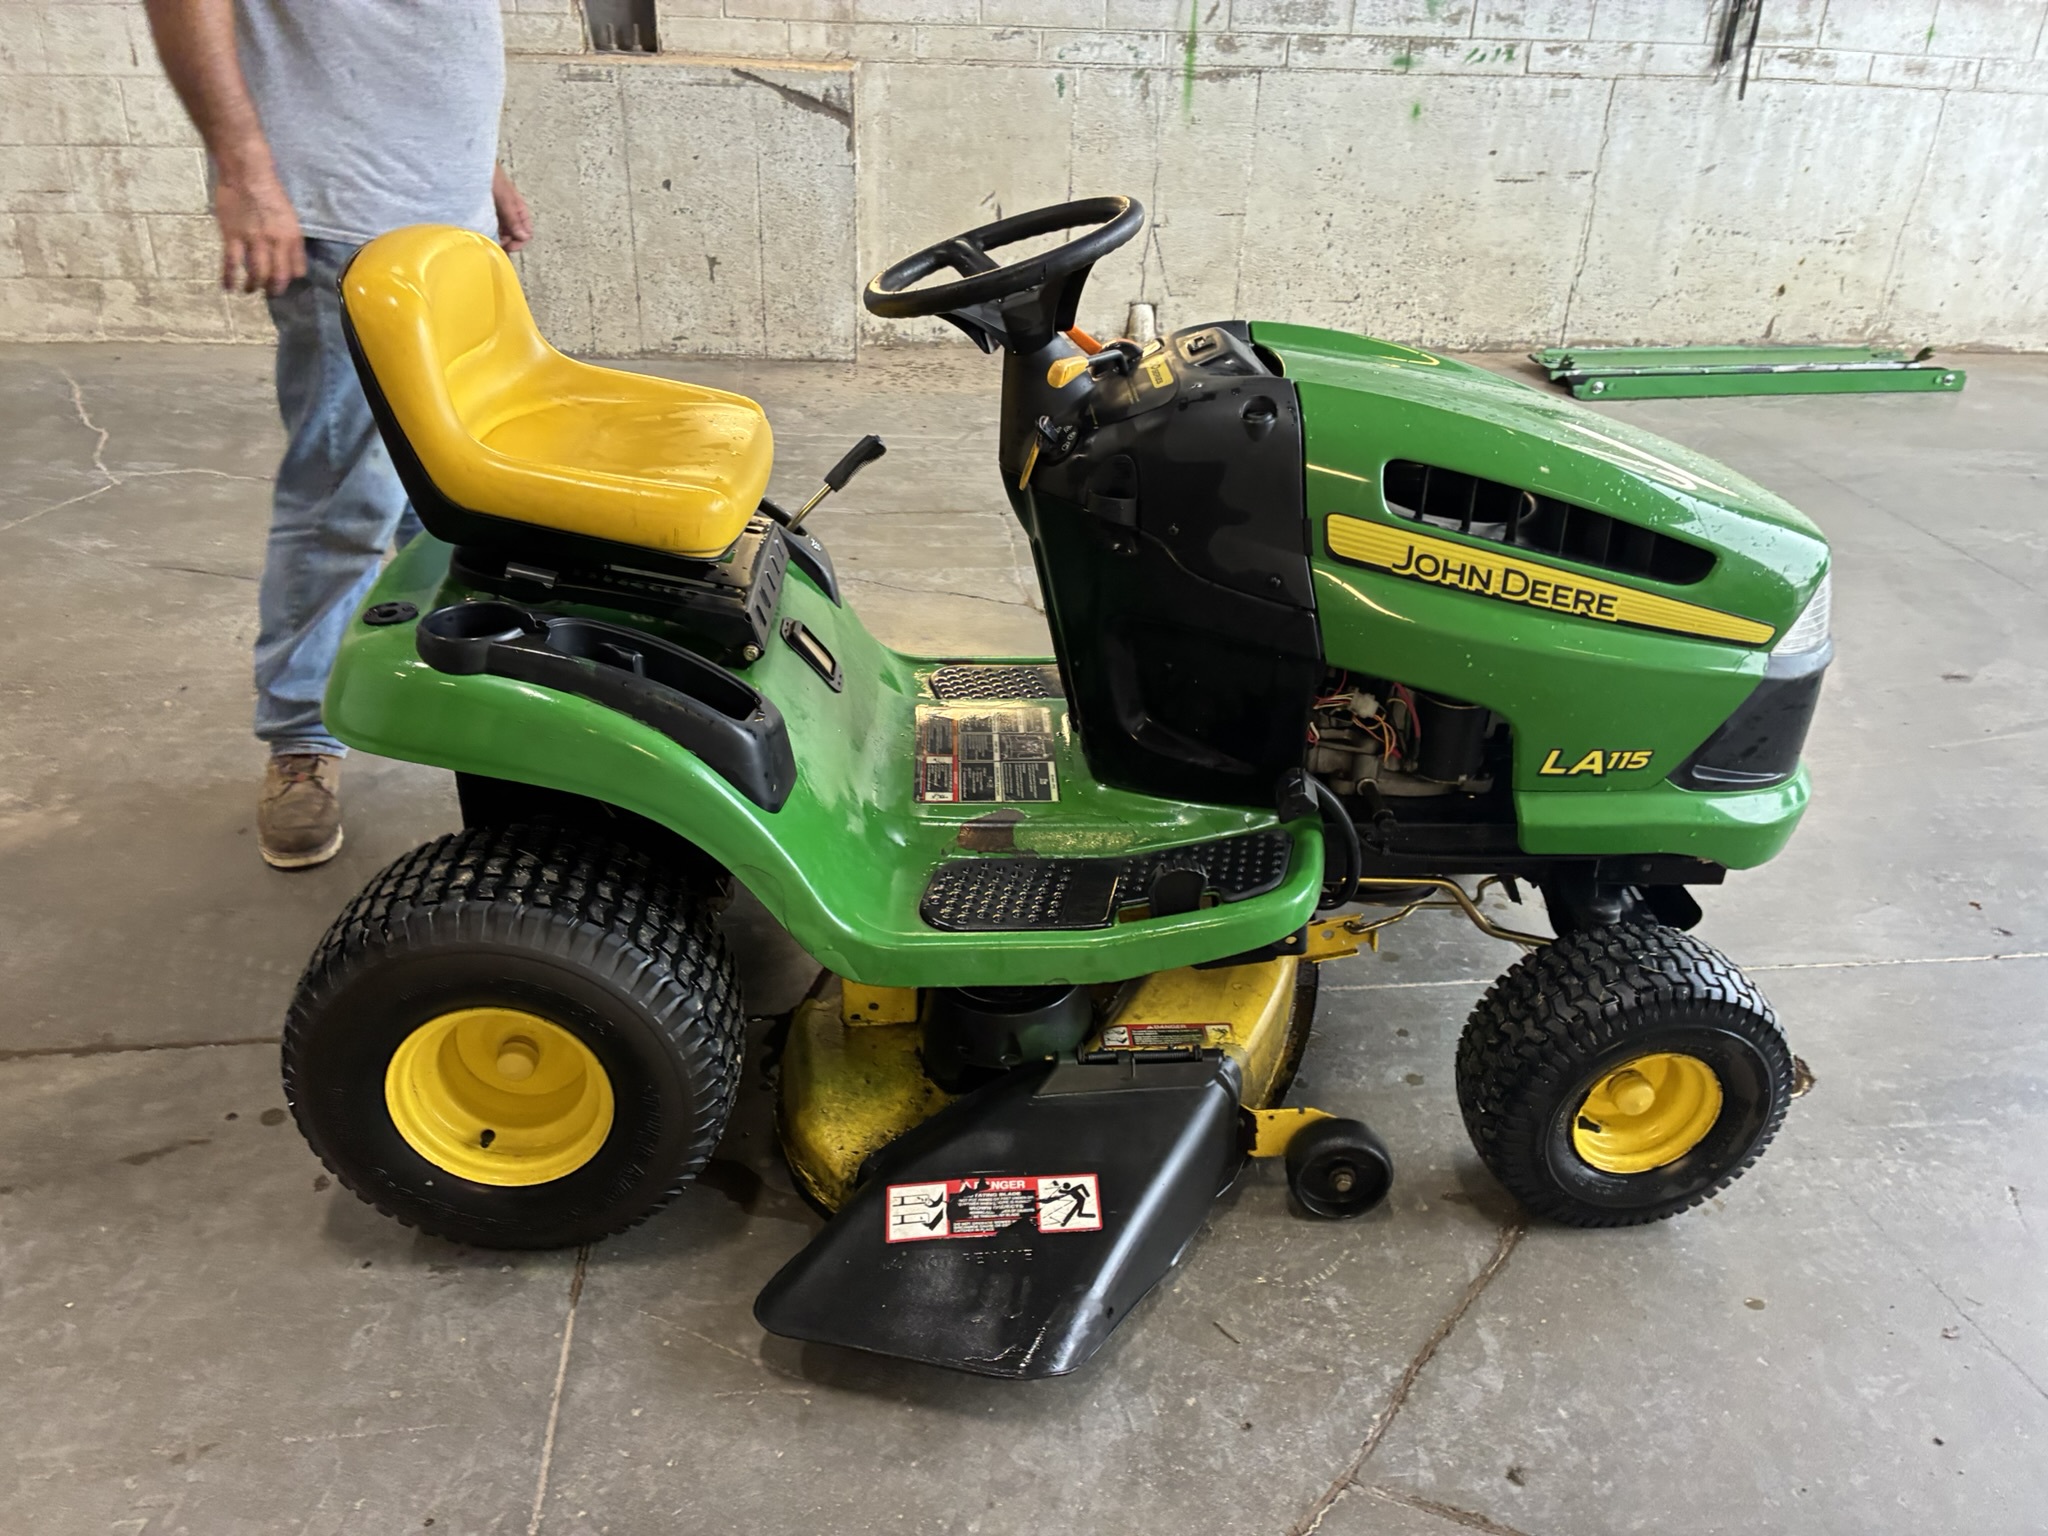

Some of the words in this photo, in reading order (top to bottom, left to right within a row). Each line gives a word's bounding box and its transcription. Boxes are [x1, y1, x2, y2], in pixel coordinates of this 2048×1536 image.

[1391, 545, 1493, 591] JOHN
[1500, 567, 1618, 618] DEERE
[1539, 748, 1655, 776] LA115
